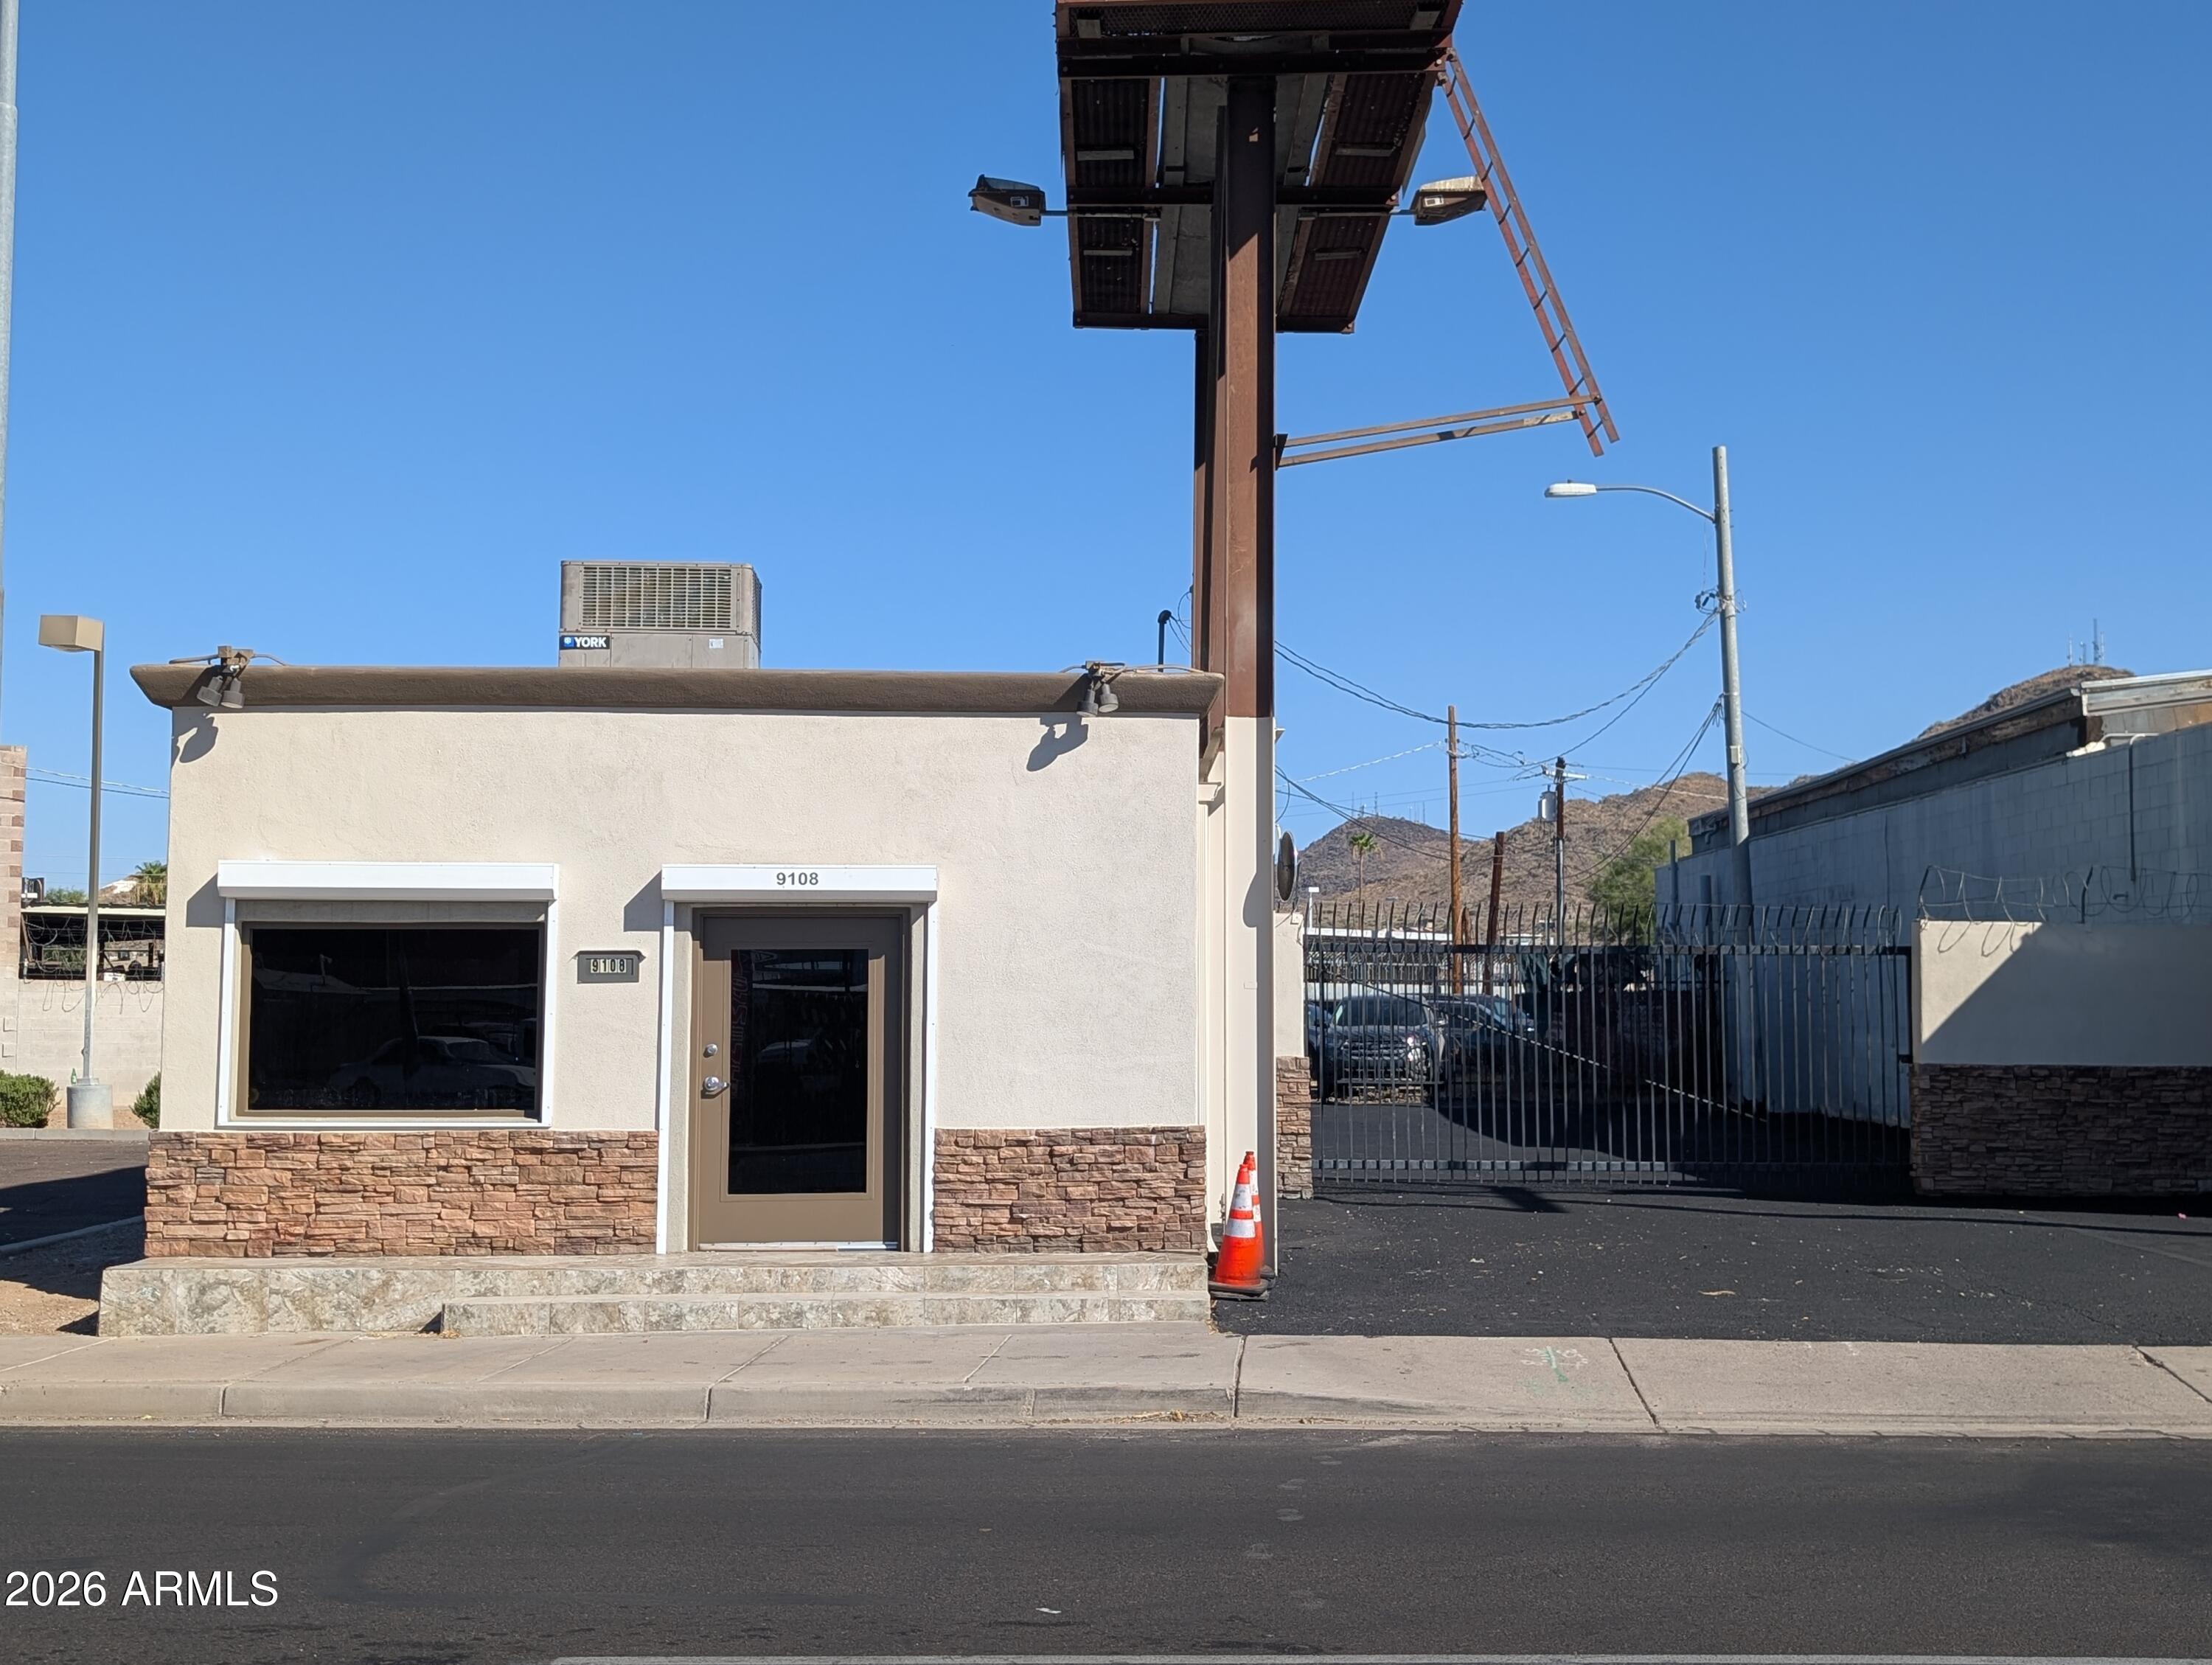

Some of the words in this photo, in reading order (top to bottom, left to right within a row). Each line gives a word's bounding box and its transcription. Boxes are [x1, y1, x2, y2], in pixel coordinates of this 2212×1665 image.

[574, 636, 607, 647] YORK
[776, 872, 818, 886] 9108
[592, 959, 625, 972] 9108
